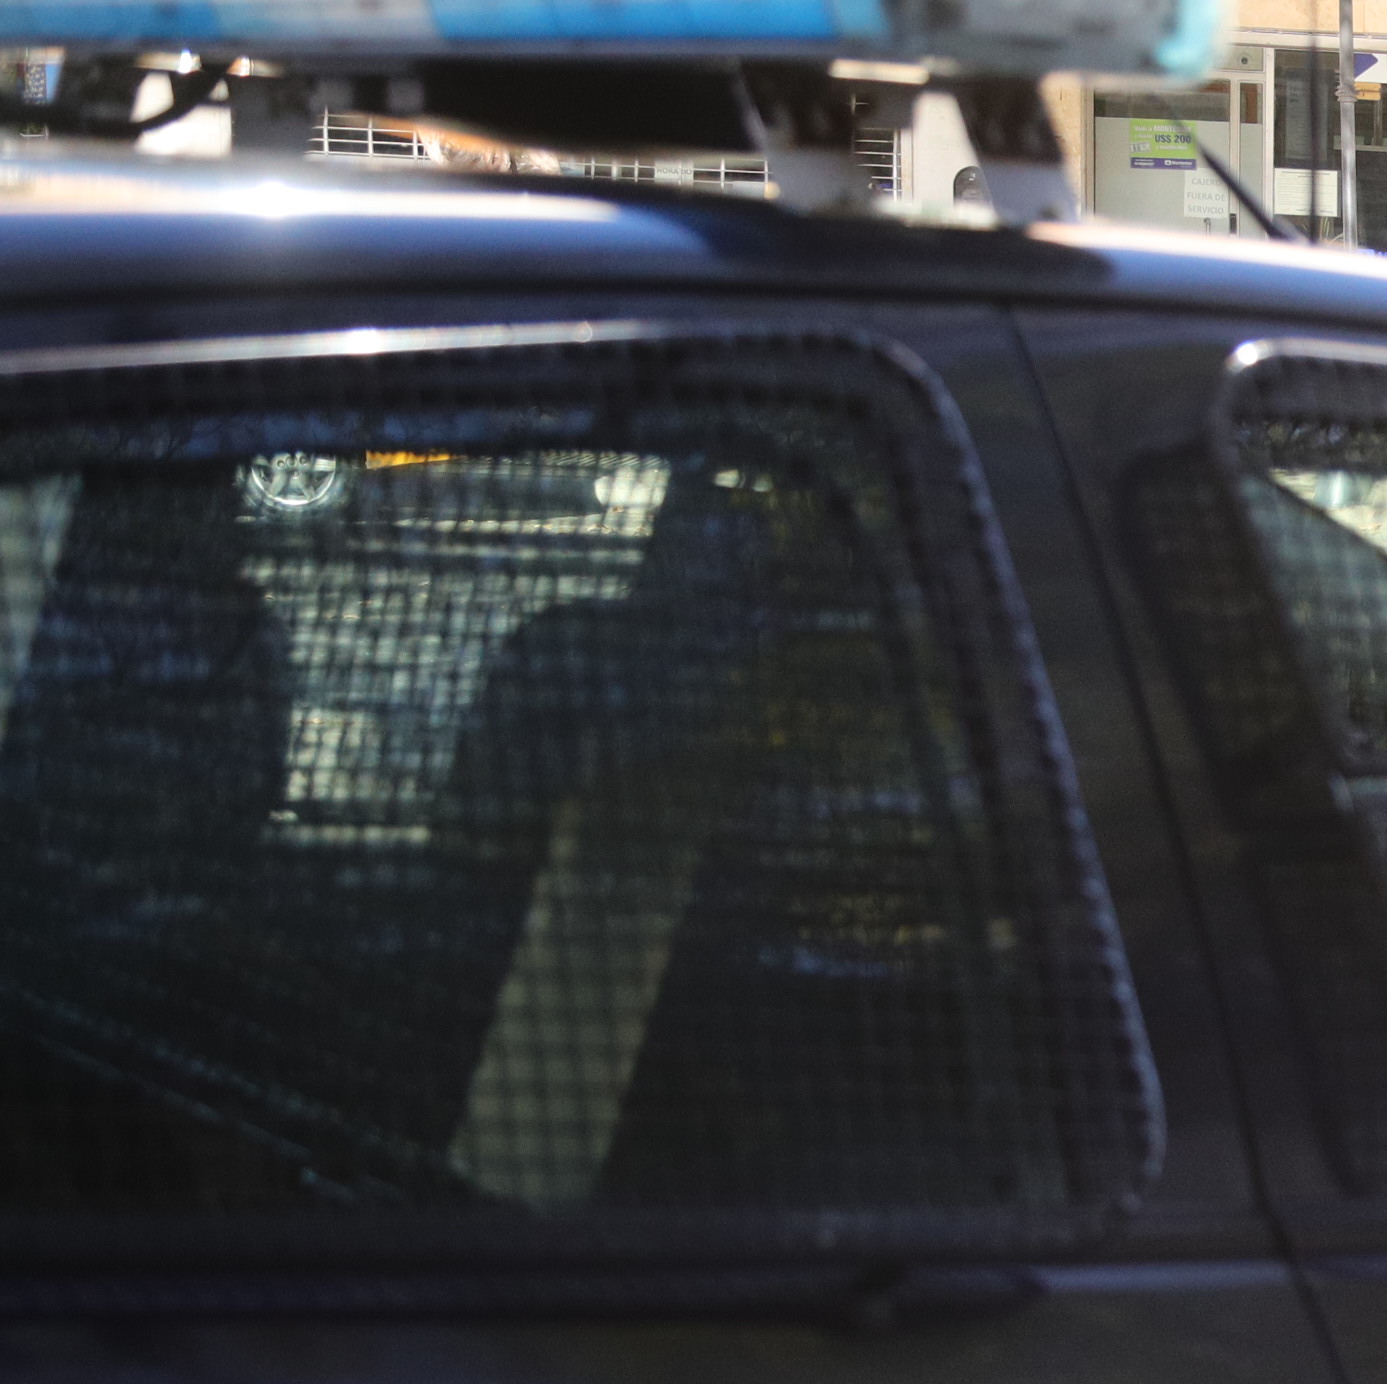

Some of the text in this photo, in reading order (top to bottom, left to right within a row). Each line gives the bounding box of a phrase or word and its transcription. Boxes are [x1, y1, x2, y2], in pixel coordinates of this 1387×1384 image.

[1173, 134, 1192, 144] 200
[1186, 192, 1226, 202] FUERA DE
[1187, 205, 1224, 215] SERVICIO
